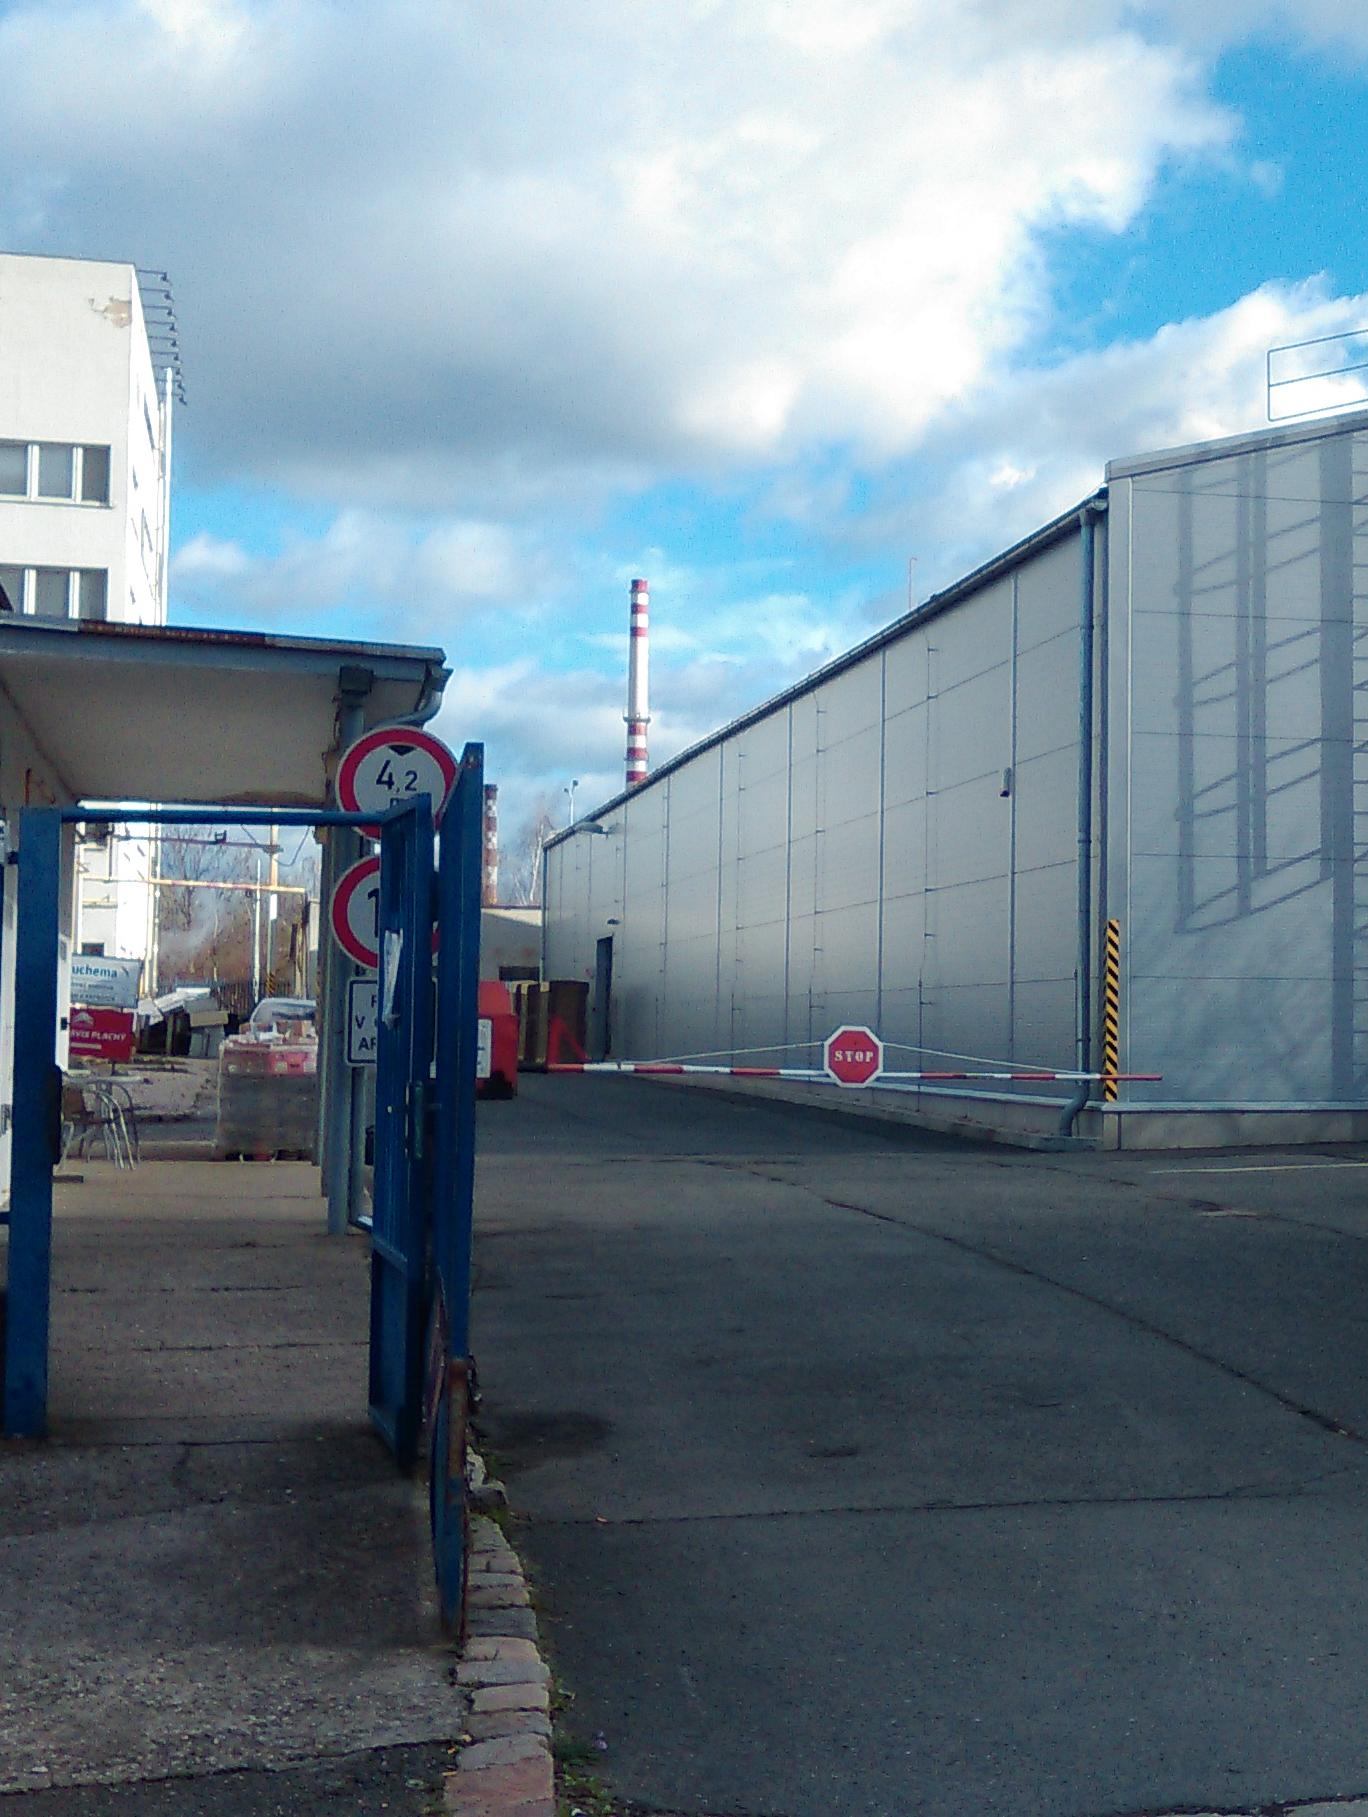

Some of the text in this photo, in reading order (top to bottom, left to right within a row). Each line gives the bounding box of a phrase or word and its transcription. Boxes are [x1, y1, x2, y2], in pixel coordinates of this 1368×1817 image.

[375, 759, 418, 793] 4,2
[71, 964, 118, 978] uchema
[834, 1050, 874, 1063] STOP
